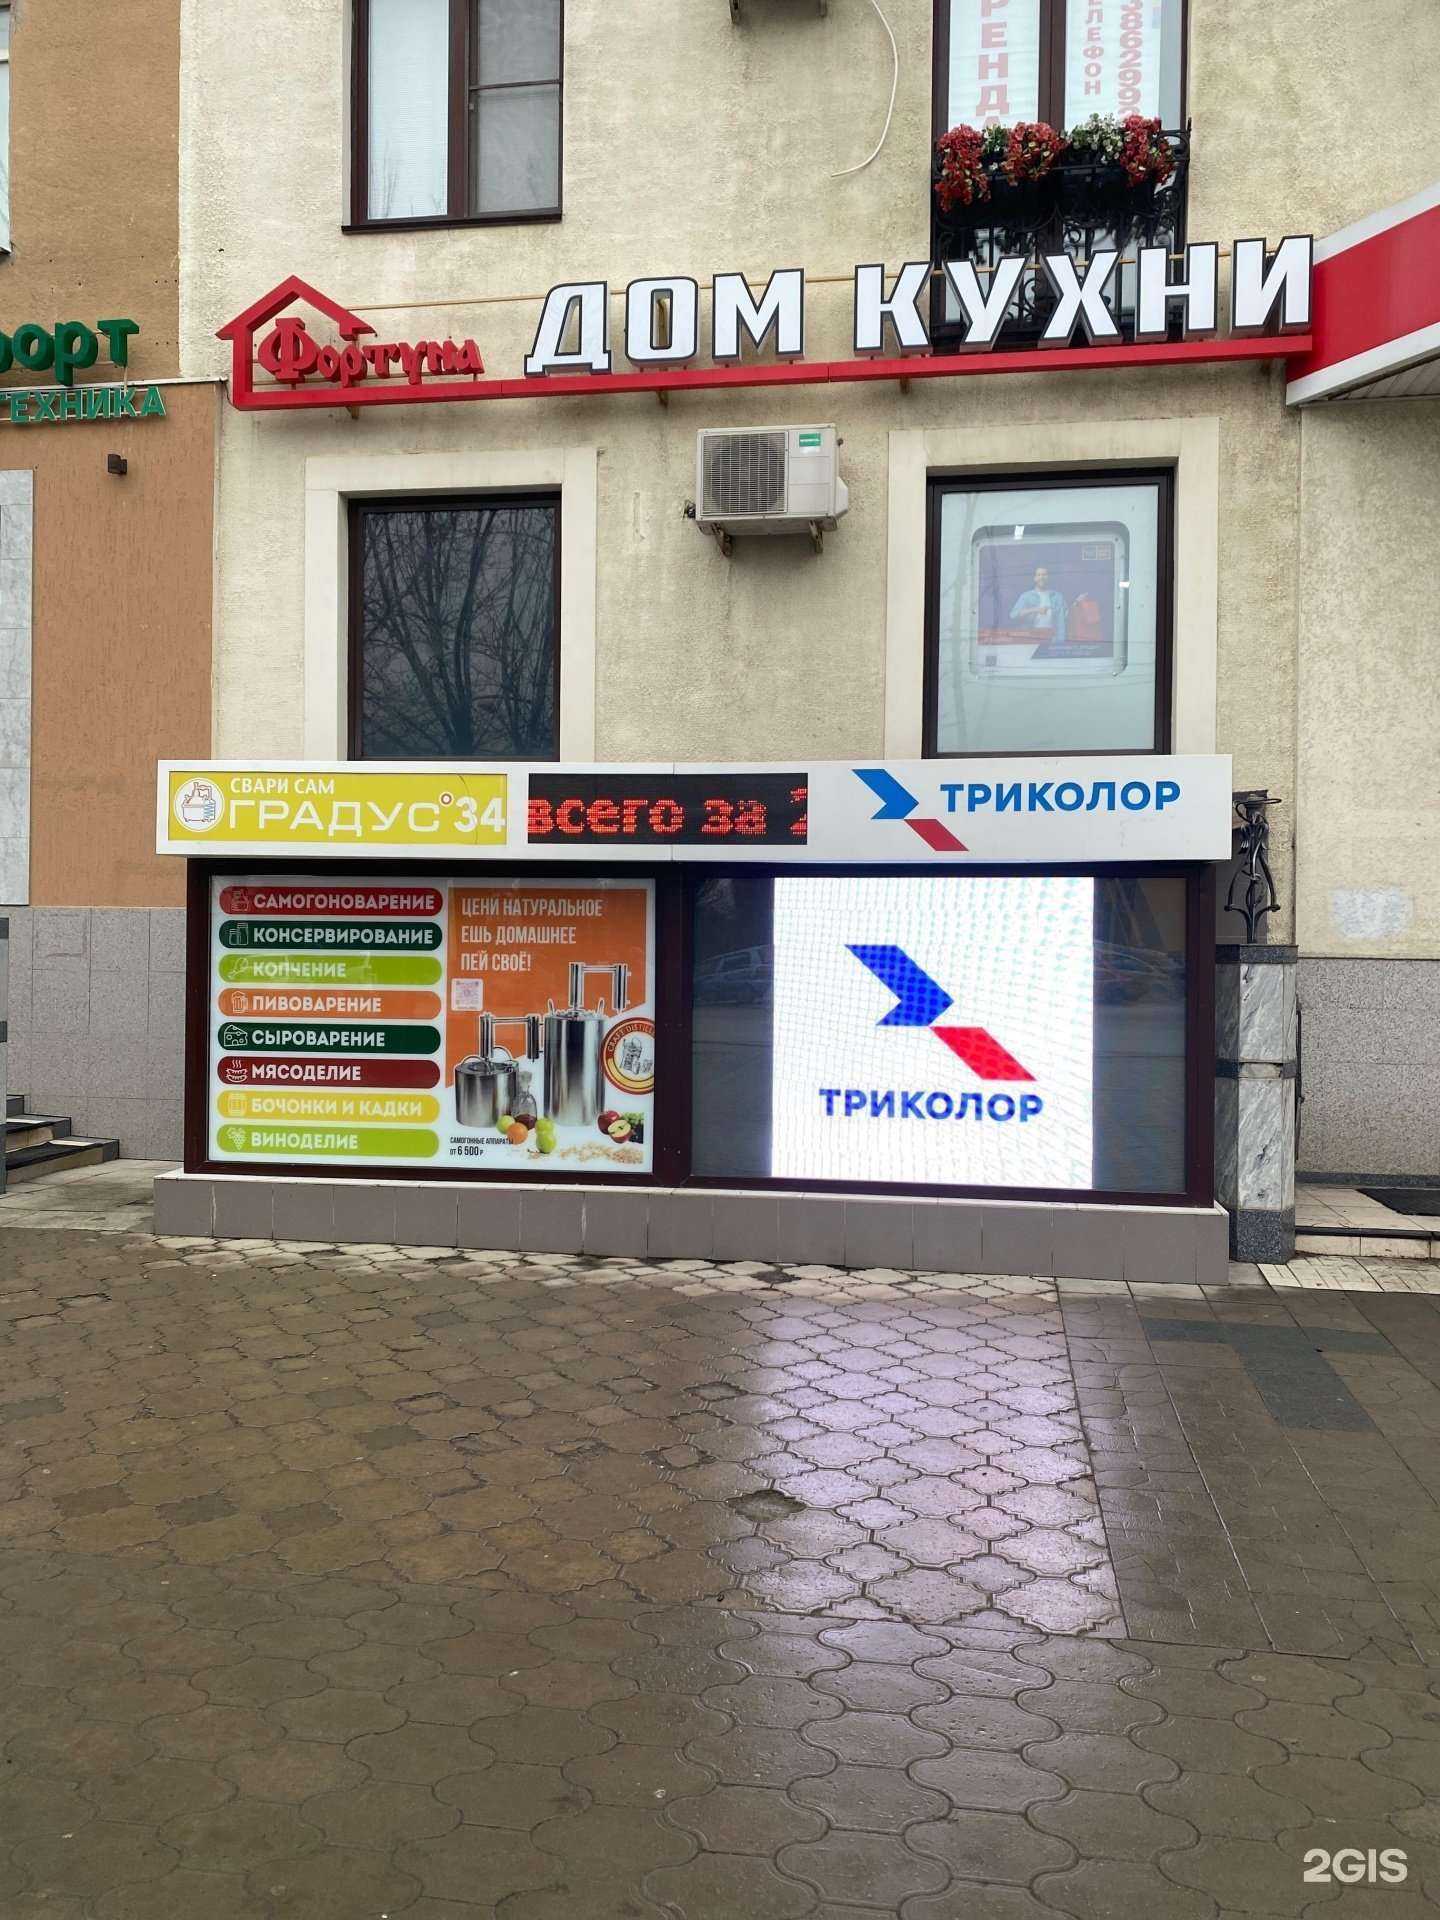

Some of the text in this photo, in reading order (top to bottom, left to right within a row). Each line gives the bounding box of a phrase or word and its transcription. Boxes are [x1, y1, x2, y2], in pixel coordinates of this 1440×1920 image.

[524, 234, 1313, 377] ДОМ КУХНИ
[0, 318, 140, 386] орт
[258, 317, 486, 387] Фортуна
[0, 386, 166, 423] ЕХНИКА
[230, 778, 335, 795] СВАРИ САМ
[940, 780, 1181, 814] ТРИКОЛОР
[253, 894, 435, 910] САМОГОНОВАРЕНИЕ
[462, 898, 603, 917] ЦЕНИ НАТУРАЛЬНОЕ
[253, 927, 433, 945] КОНСЕРВИРОВАНИЕ
[461, 925, 577, 945] ЕШЬ ДОМАШНЕЕ
[252, 961, 347, 978] КОПЧЕНИЕ
[461, 951, 532, 972] ПЕЙ СВОЁ!
[252, 995, 382, 1013] ПИВОВАРЕНИЕ
[251, 1030, 386, 1047] СЫРОВАРЕНИЕ
[251, 1064, 362, 1082] МЯСОДЕЛИЕ
[251, 1098, 422, 1117] БОЧОНКИ И КАДКИ
[819, 1088, 1043, 1122] ТРИКОЛОР
[251, 1131, 358, 1150] ВИНОДЕЛИЕ
